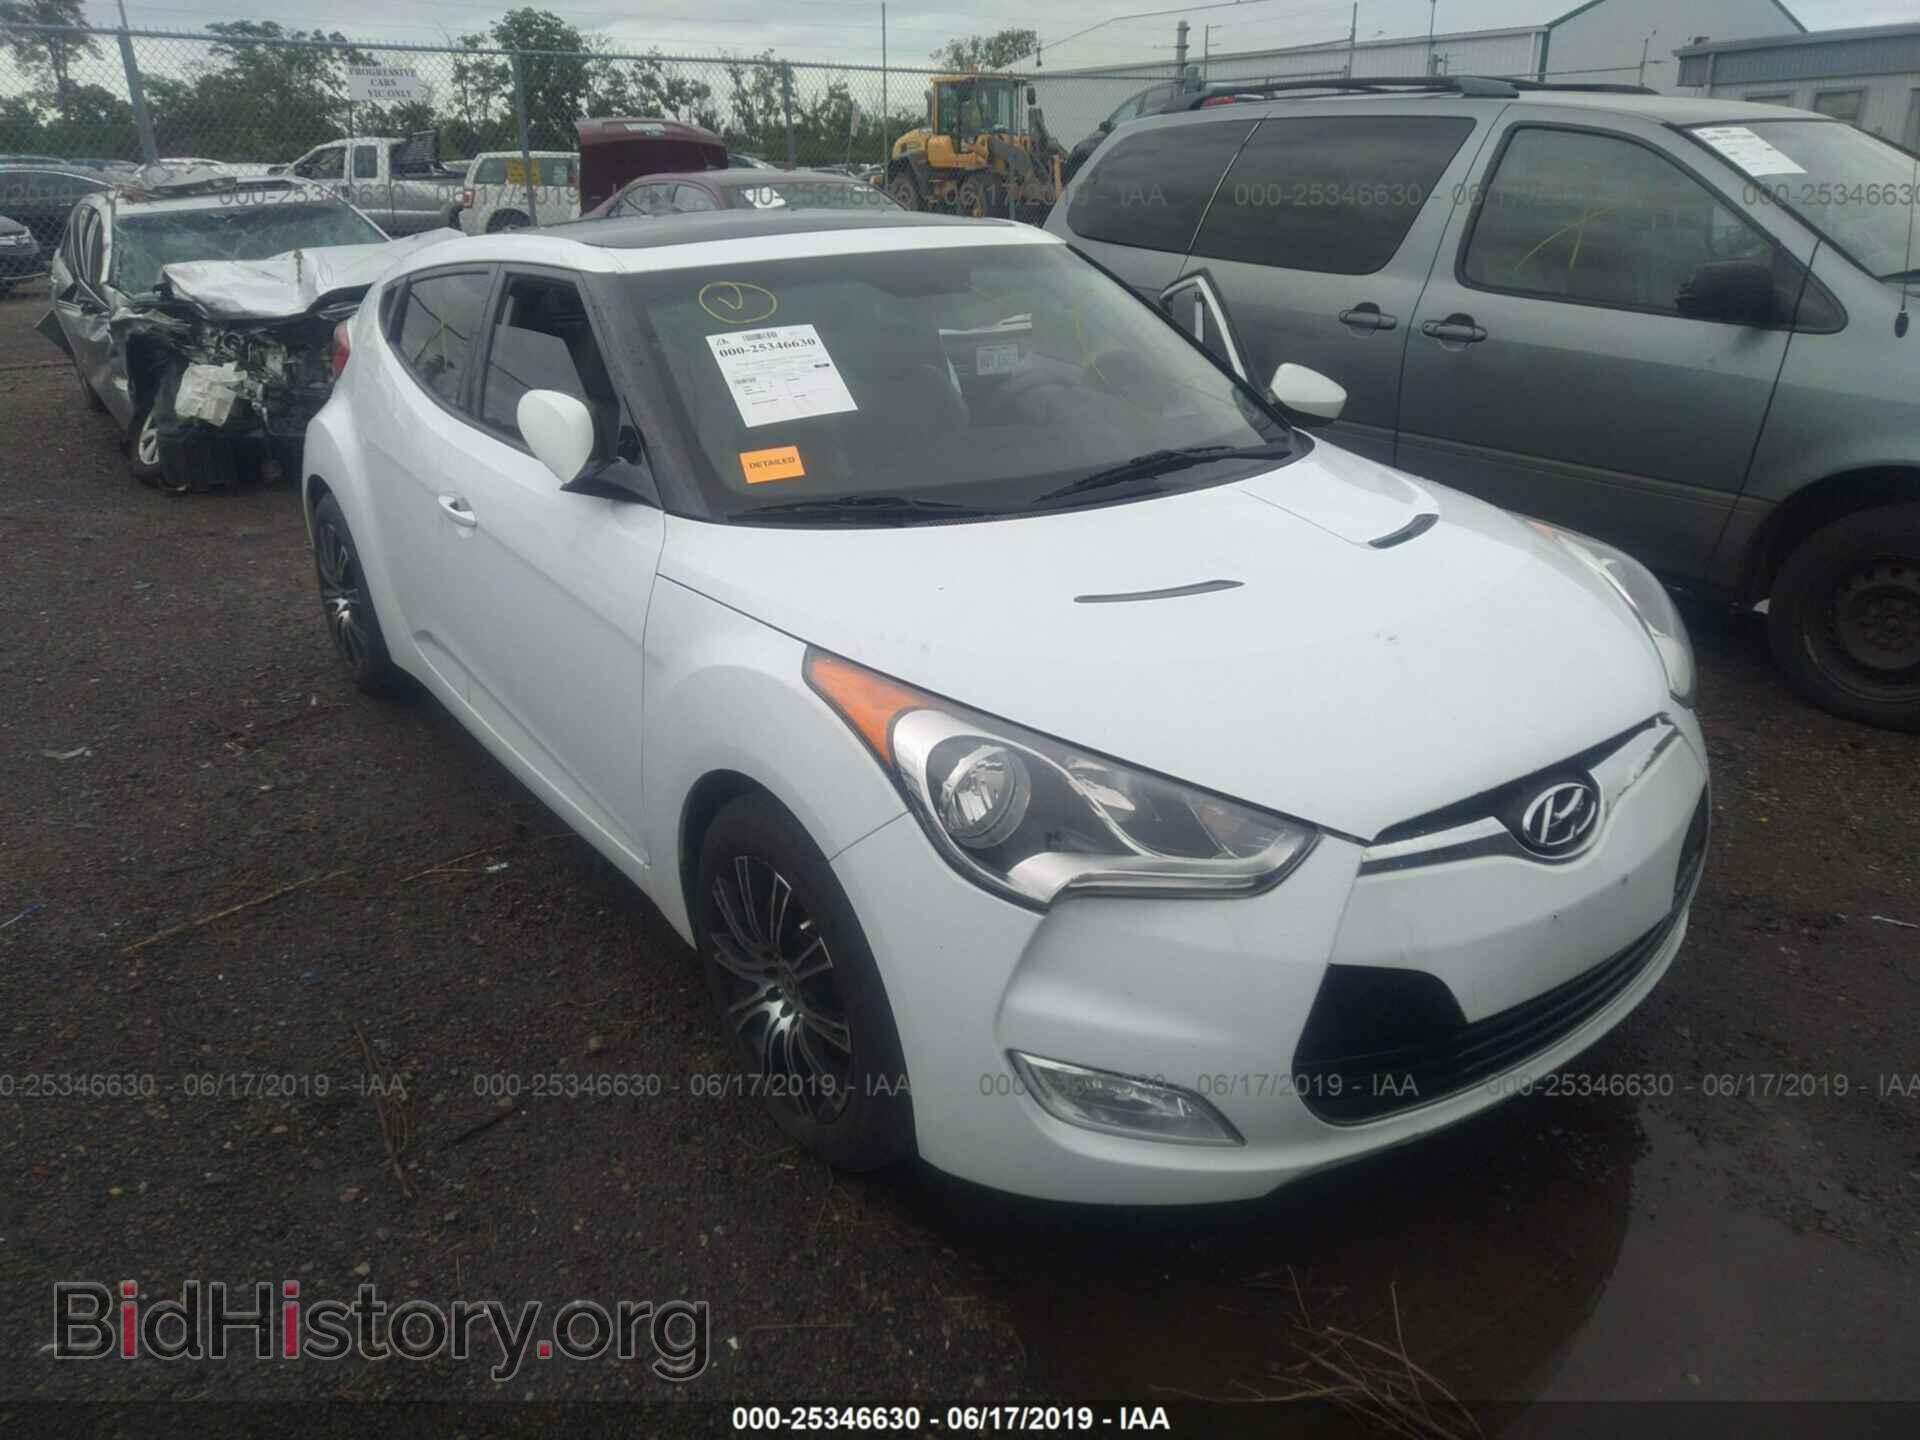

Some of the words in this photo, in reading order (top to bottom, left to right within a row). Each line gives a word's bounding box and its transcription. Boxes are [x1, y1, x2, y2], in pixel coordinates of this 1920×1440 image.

[370, 79, 397, 87] CARS
[386, 89, 412, 98] ONLY
[719, 337, 817, 358] 000-25346630
[748, 456, 796, 469] DETAILED
